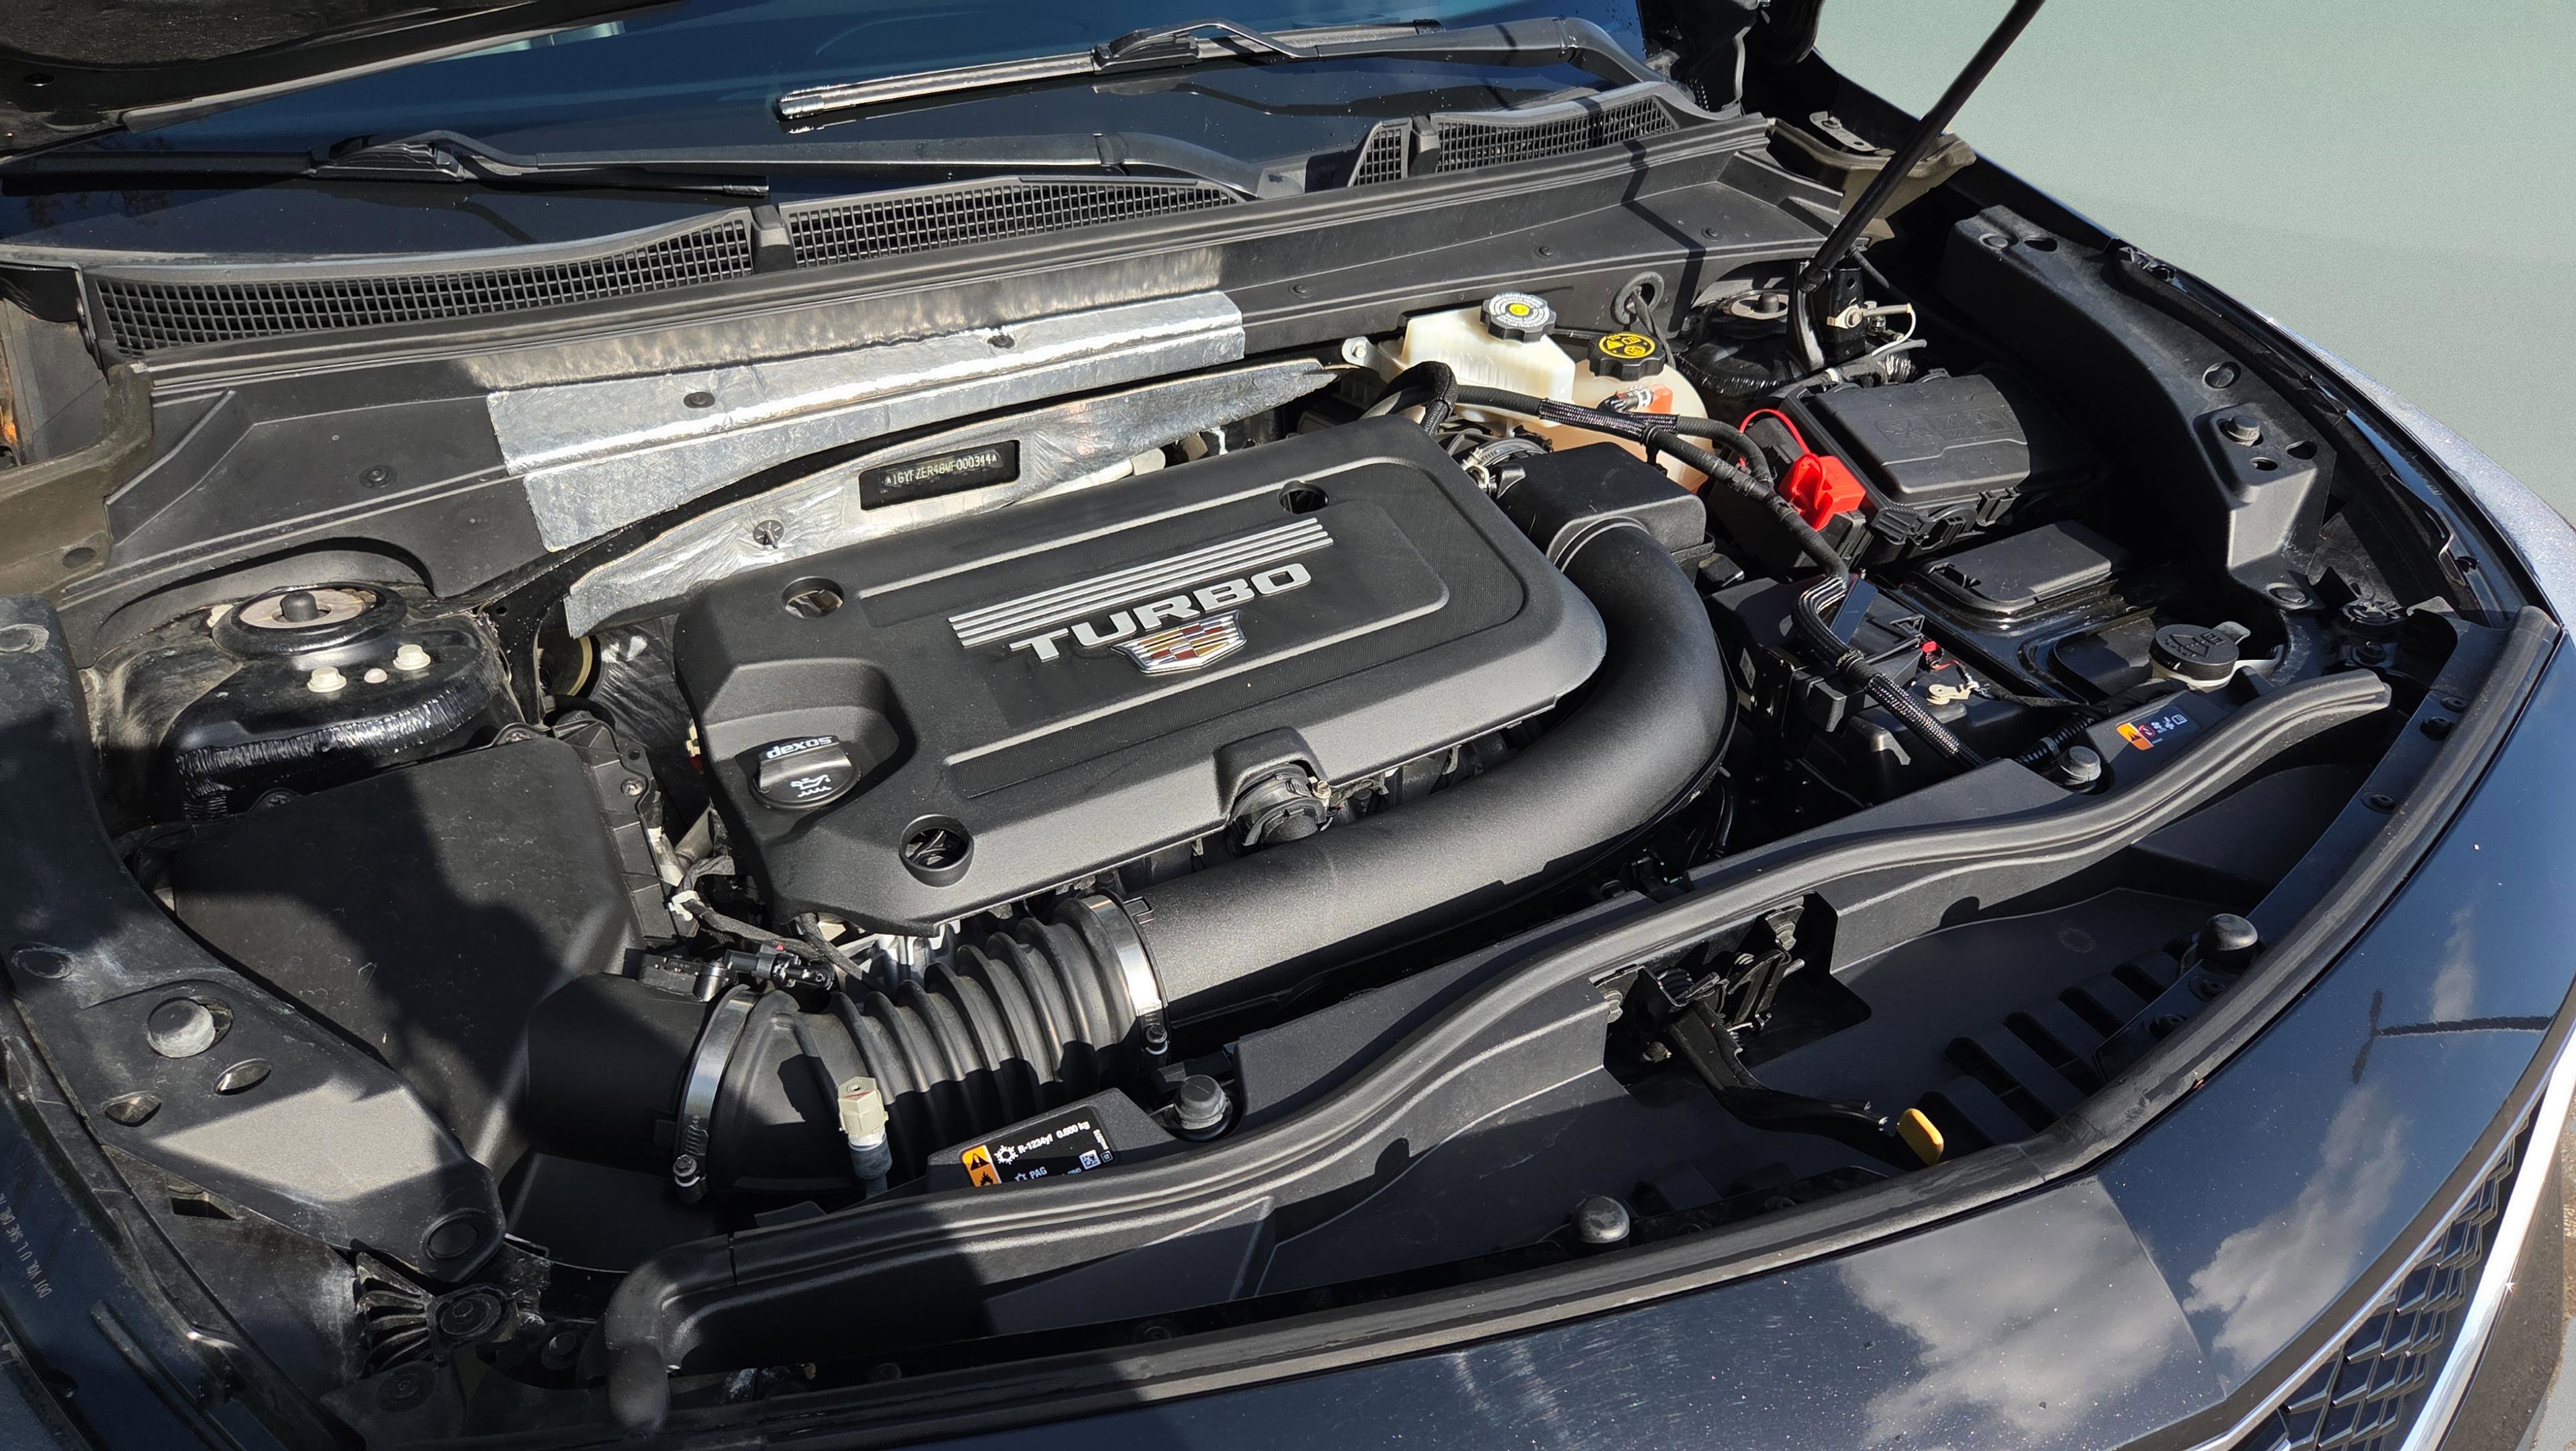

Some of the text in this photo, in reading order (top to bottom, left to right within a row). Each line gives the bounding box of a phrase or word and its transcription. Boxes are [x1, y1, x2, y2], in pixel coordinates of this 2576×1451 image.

[1009, 562, 1312, 662] TURBO
[766, 736, 833, 759] dexos
[1029, 1166, 1048, 1178] PAG
